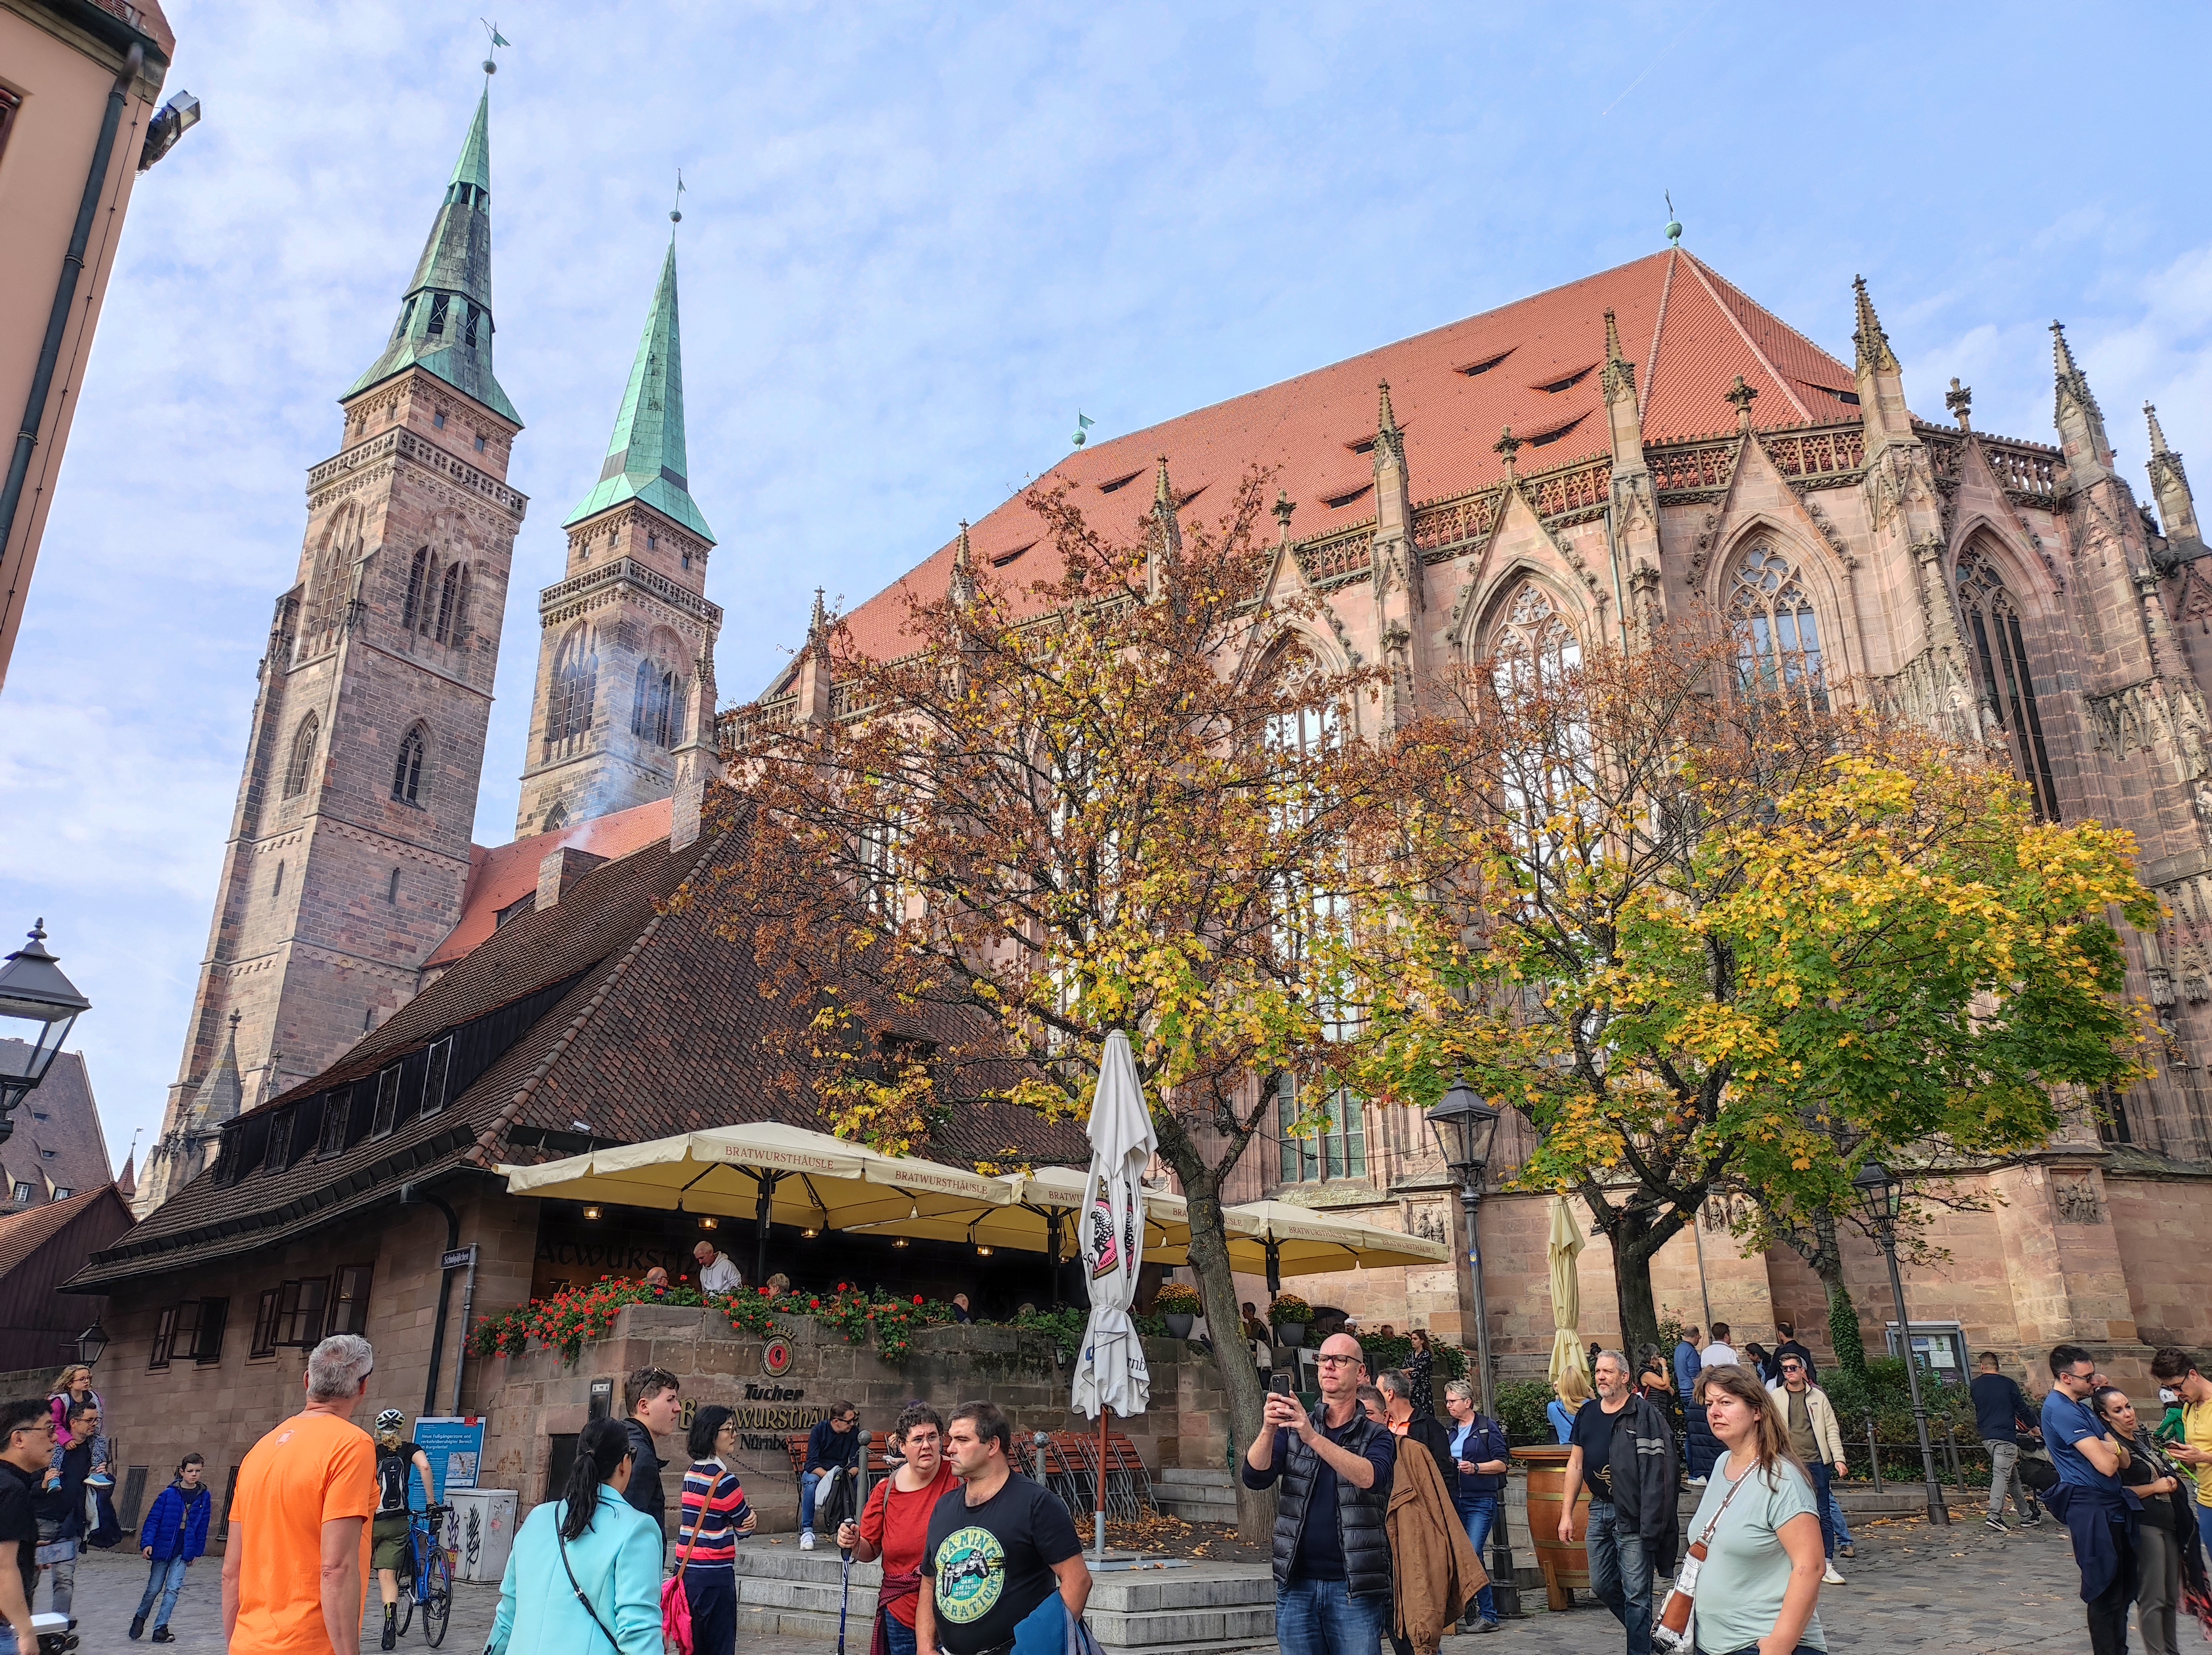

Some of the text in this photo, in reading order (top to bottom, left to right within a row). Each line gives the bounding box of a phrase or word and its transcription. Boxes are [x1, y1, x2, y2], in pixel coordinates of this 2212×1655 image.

[725, 1145, 834, 1169] BRATWURSTHÄUSLE
[895, 1170, 988, 1195] BRATWURSTHÄUSLE
[1048, 1191, 1085, 1202] BRATWU
[1288, 1226, 1349, 1240] BRATWURSTHÄUSLE
[1382, 1239, 1436, 1254] BRATWURSTHÄUSLE
[745, 1384, 804, 1400] Tucher
[740, 1433, 788, 1451] Nürnbe
